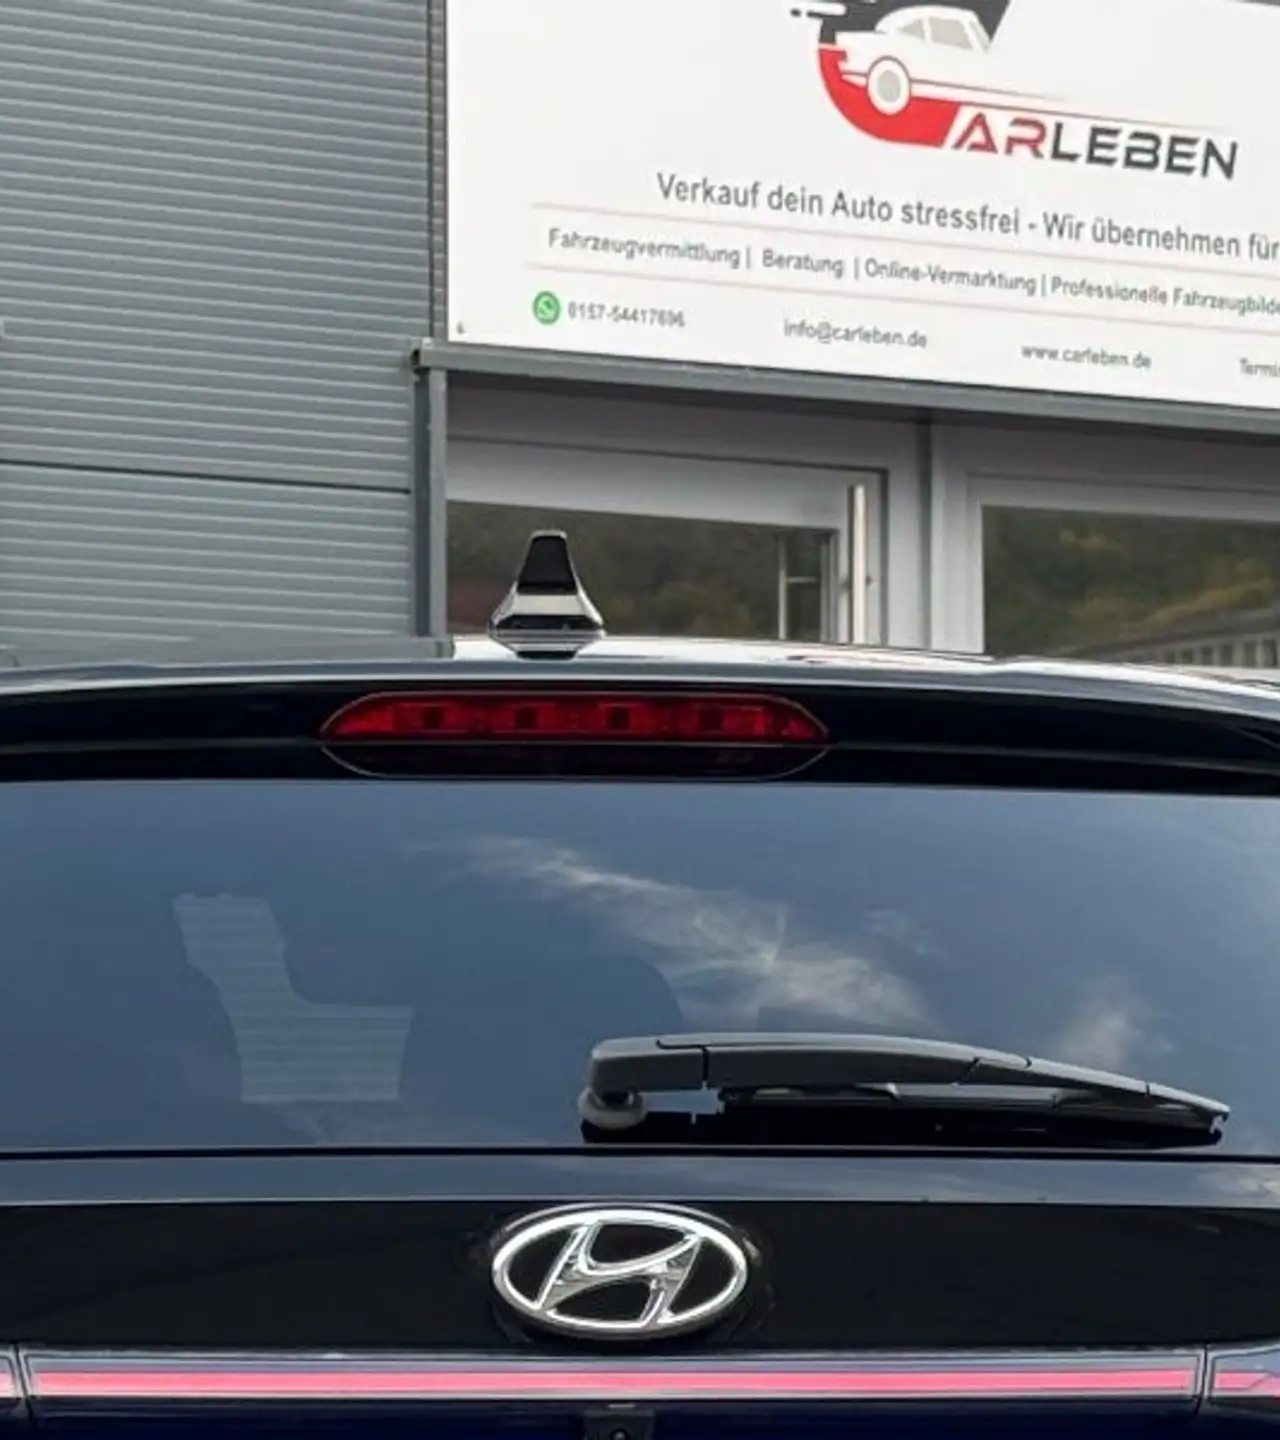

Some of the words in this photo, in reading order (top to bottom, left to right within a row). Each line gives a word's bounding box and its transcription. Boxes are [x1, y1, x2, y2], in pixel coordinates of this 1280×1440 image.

[656, 172, 762, 209] Verkauf
[767, 185, 823, 215] dein
[831, 190, 893, 222] Auto
[901, 202, 1020, 235] stressfrei
[1042, 211, 1086, 241] Wir
[1091, 216, 1241, 257] übernehmen
[1248, 233, 1280, 262] für
[548, 228, 740, 270] Fahrzeugvermittlung
[762, 249, 844, 279] Beratung
[864, 258, 1037, 296] Online-Vermarktung
[1050, 275, 1168, 305] Professionelle
[783, 319, 928, 348] info@carleben.de
[1021, 346, 1152, 369] www.carleben.de
